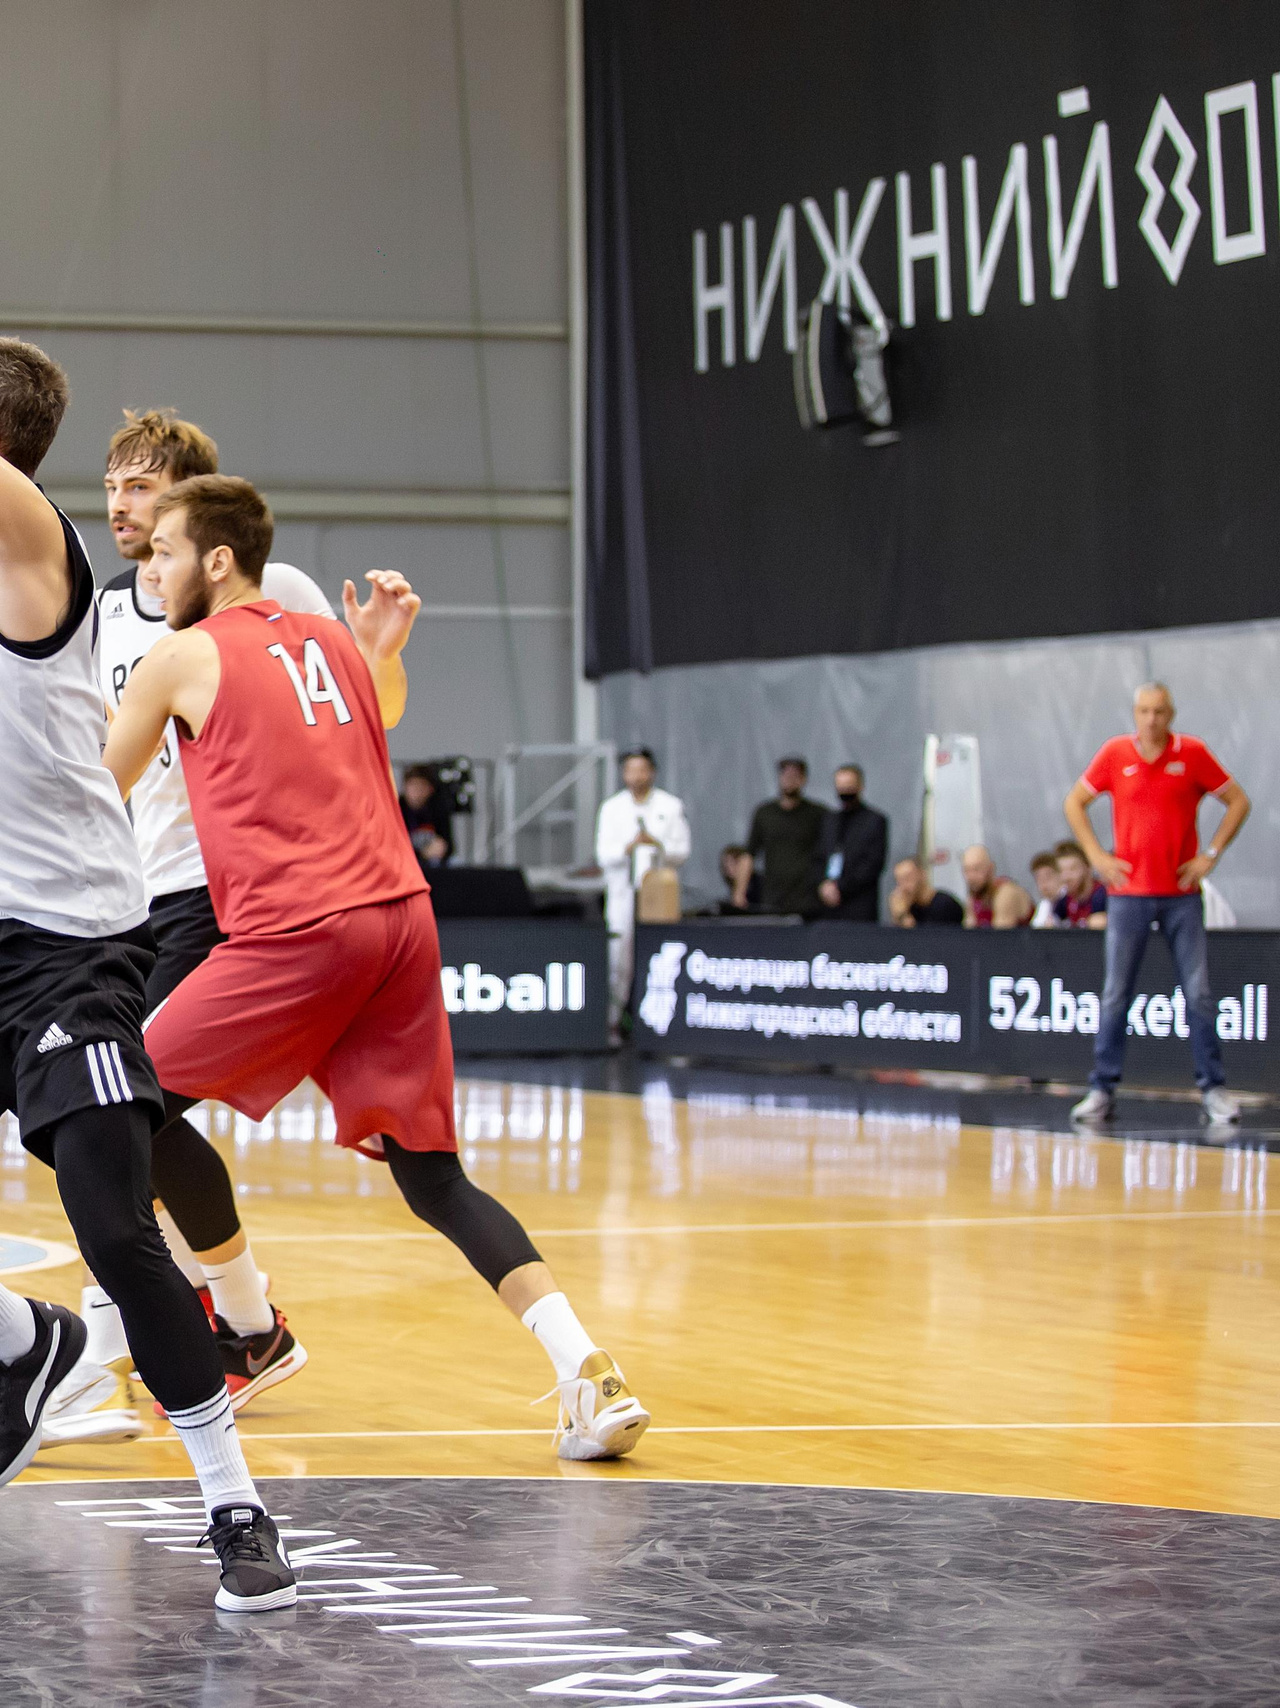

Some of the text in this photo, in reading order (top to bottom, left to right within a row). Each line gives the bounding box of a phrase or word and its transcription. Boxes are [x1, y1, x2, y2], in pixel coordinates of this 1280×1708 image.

[692, 86, 1120, 374] НИЖНИЙ
[266, 637, 353, 726] 14
[36, 1034, 73, 1054] adidas
